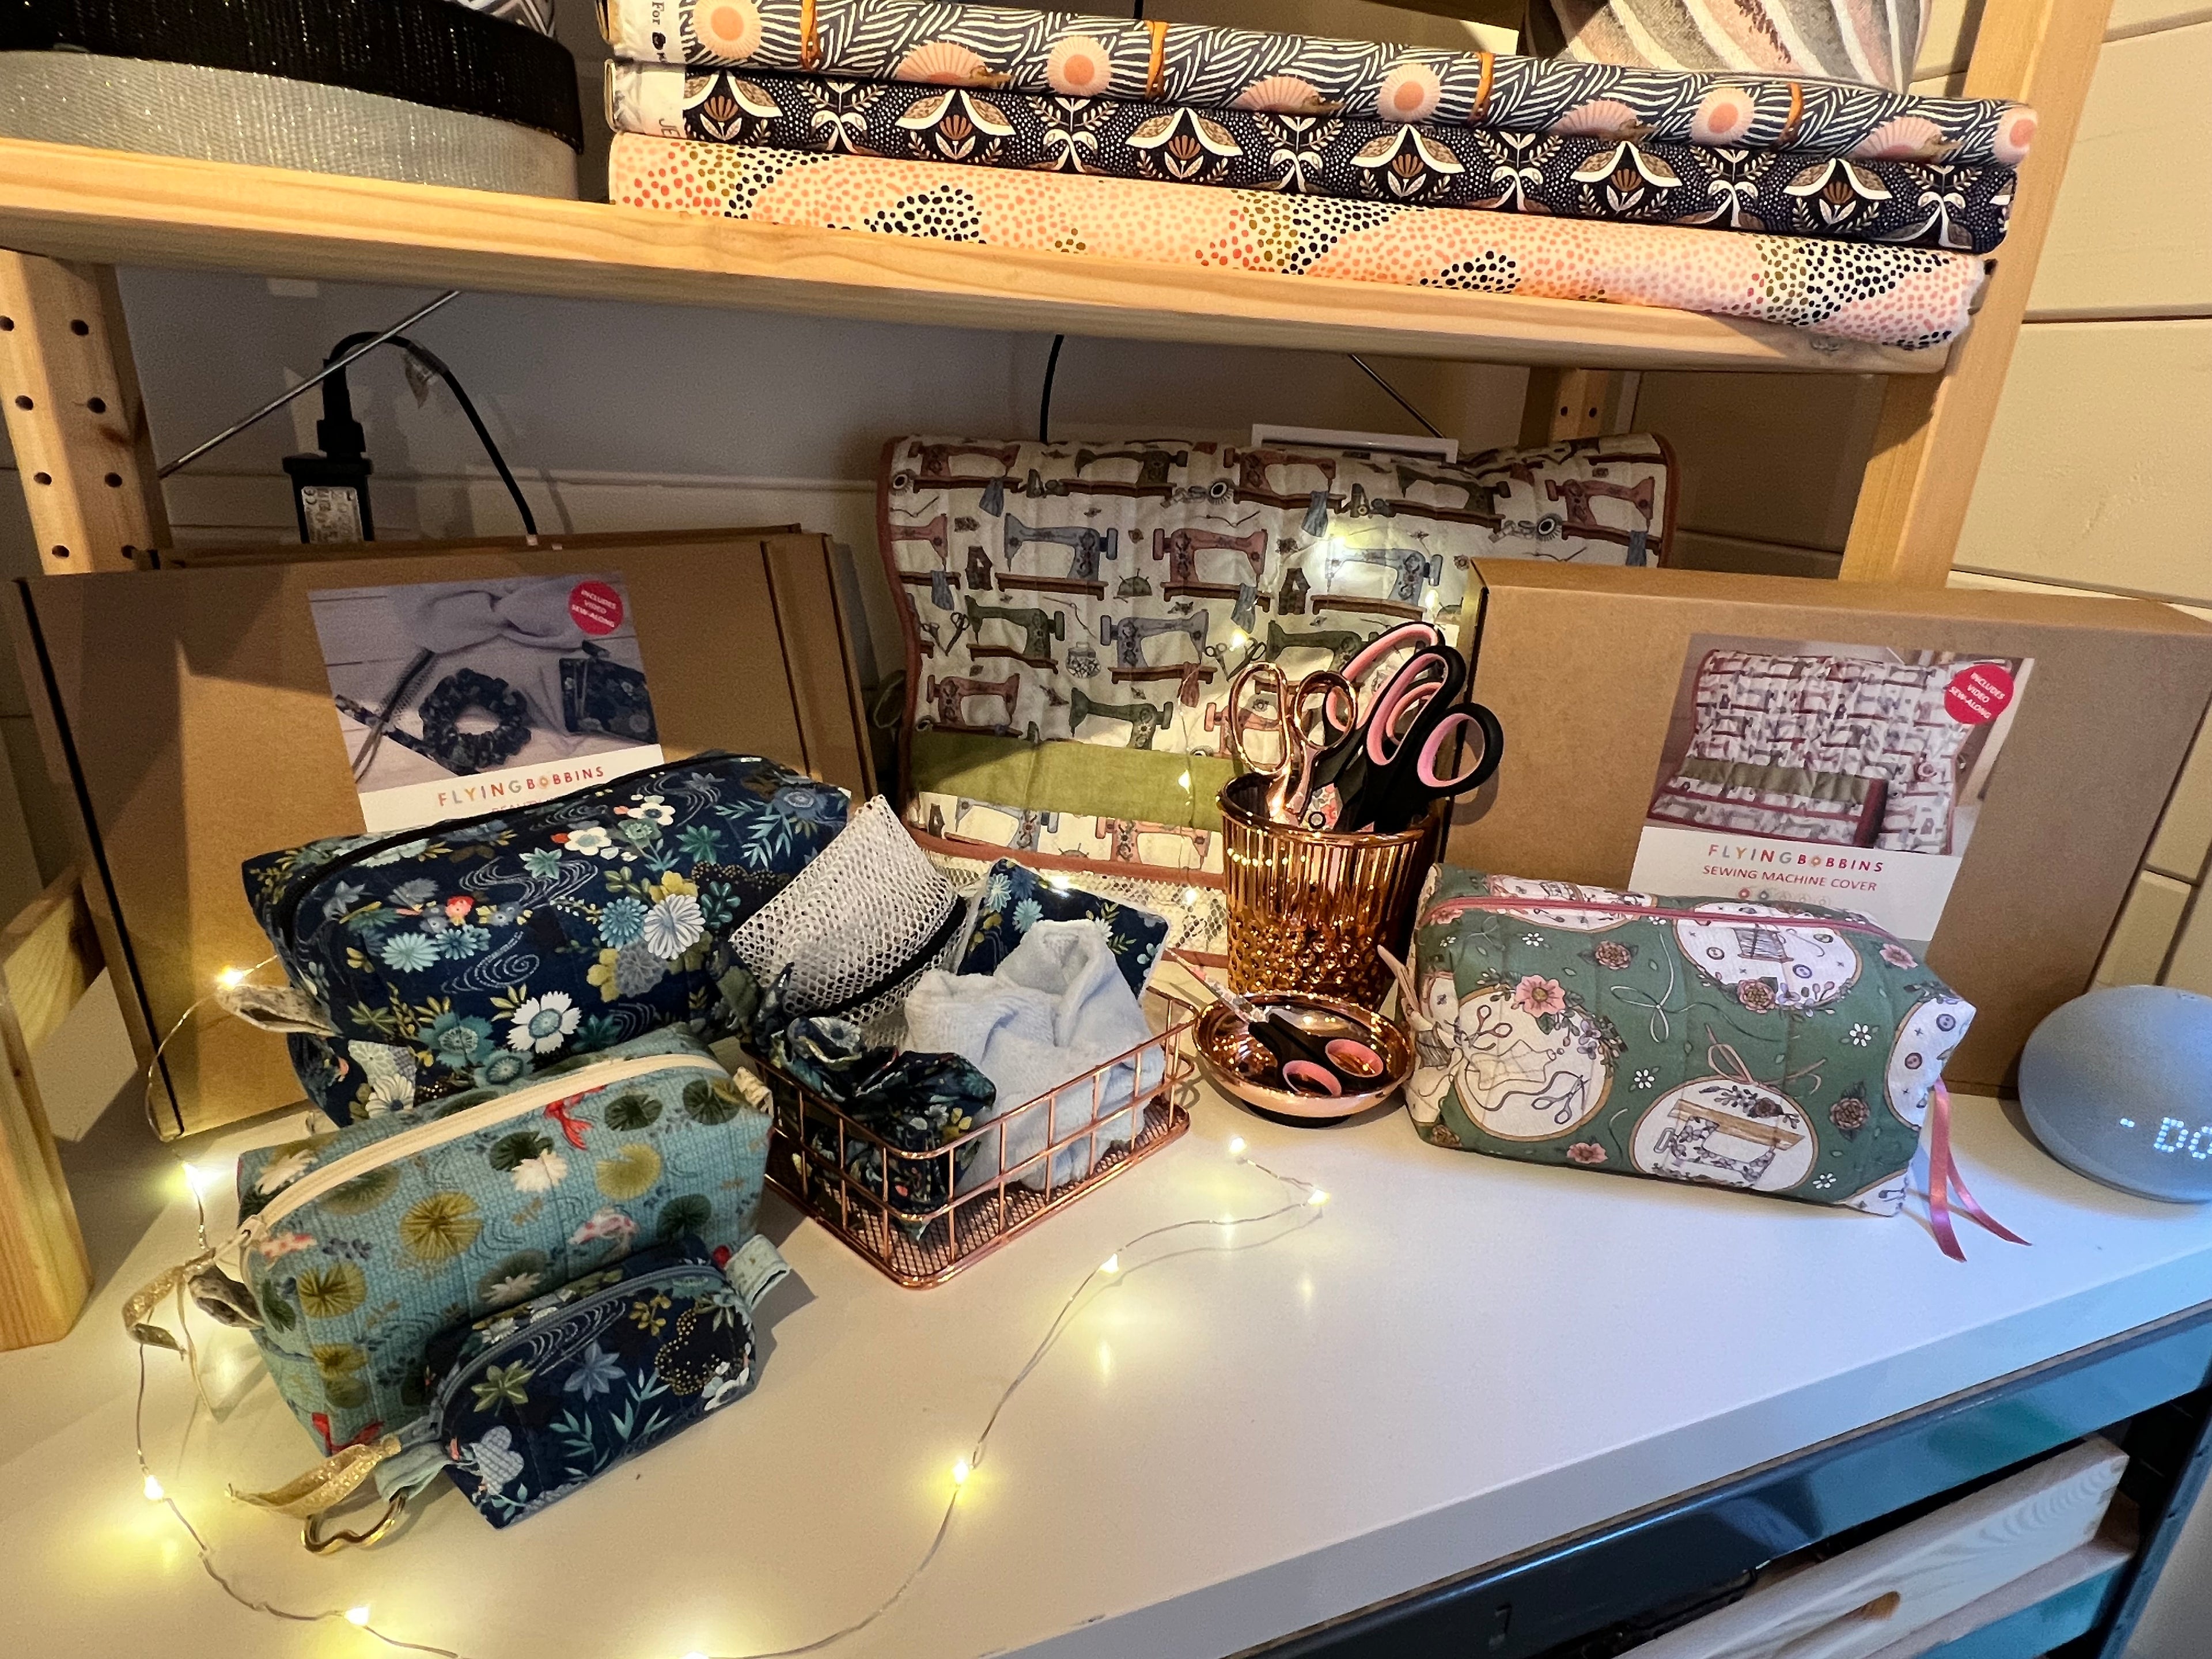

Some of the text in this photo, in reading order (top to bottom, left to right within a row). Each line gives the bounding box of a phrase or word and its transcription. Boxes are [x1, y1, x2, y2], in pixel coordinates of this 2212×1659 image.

[652, 1, 665, 25] For
[581, 589, 616, 610] INCLUDES
[584, 599, 607, 615] VIDEO
[571, 604, 615, 628] SEW-ALONG
[1967, 683, 1990, 703] VIDEO
[1970, 672, 2006, 700] INCLUDES
[1948, 685, 1992, 719] SEW-ALONG
[1702, 865, 1878, 892] SEWING MACHINE COVER
